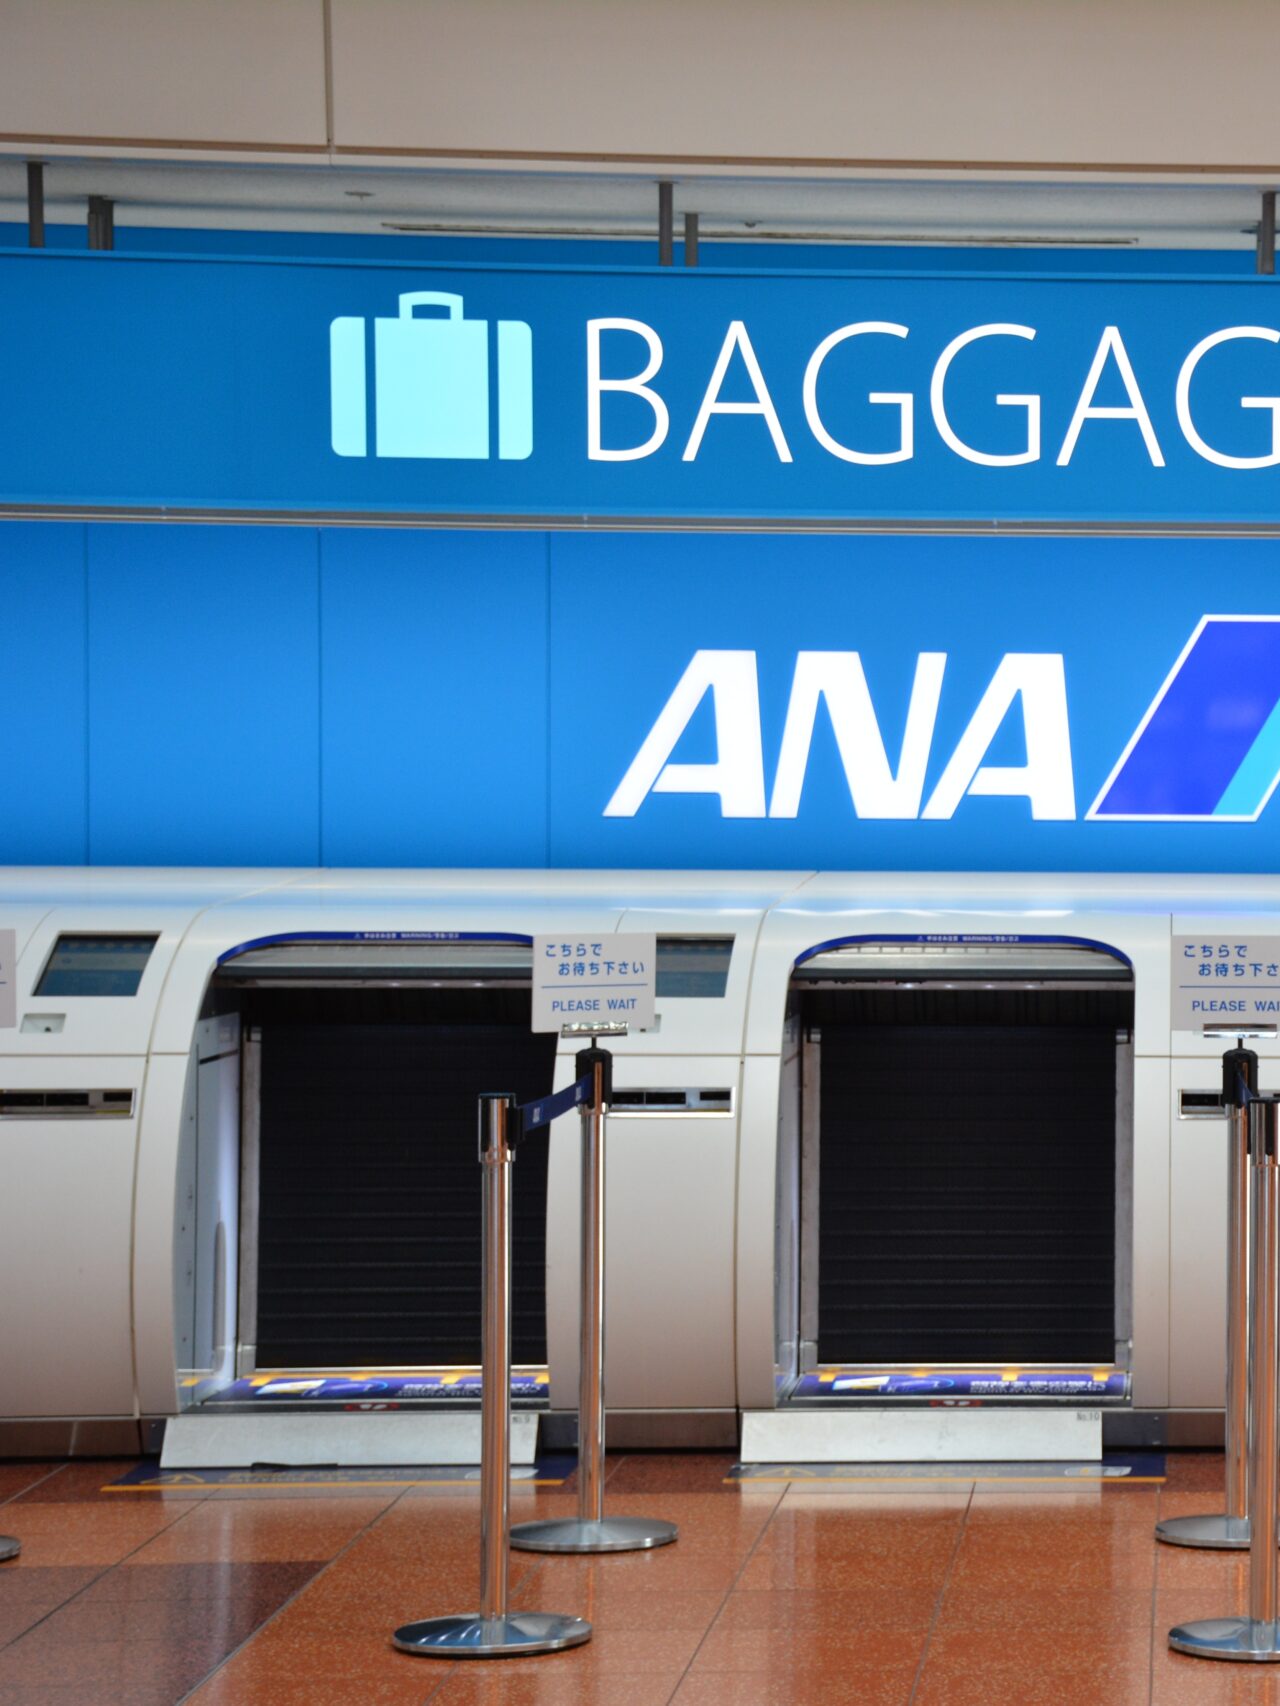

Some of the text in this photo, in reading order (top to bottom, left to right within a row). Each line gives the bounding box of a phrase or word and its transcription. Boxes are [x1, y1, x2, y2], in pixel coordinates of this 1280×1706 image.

[603, 649, 1077, 821] ANA
[545, 943, 602, 957] こちらで
[1184, 944, 1248, 958] こちらで
[558, 961, 645, 976] お待ち下さい
[552, 998, 638, 1012] PLEASE WAIT
[1192, 1000, 1247, 1012] PLEASE
